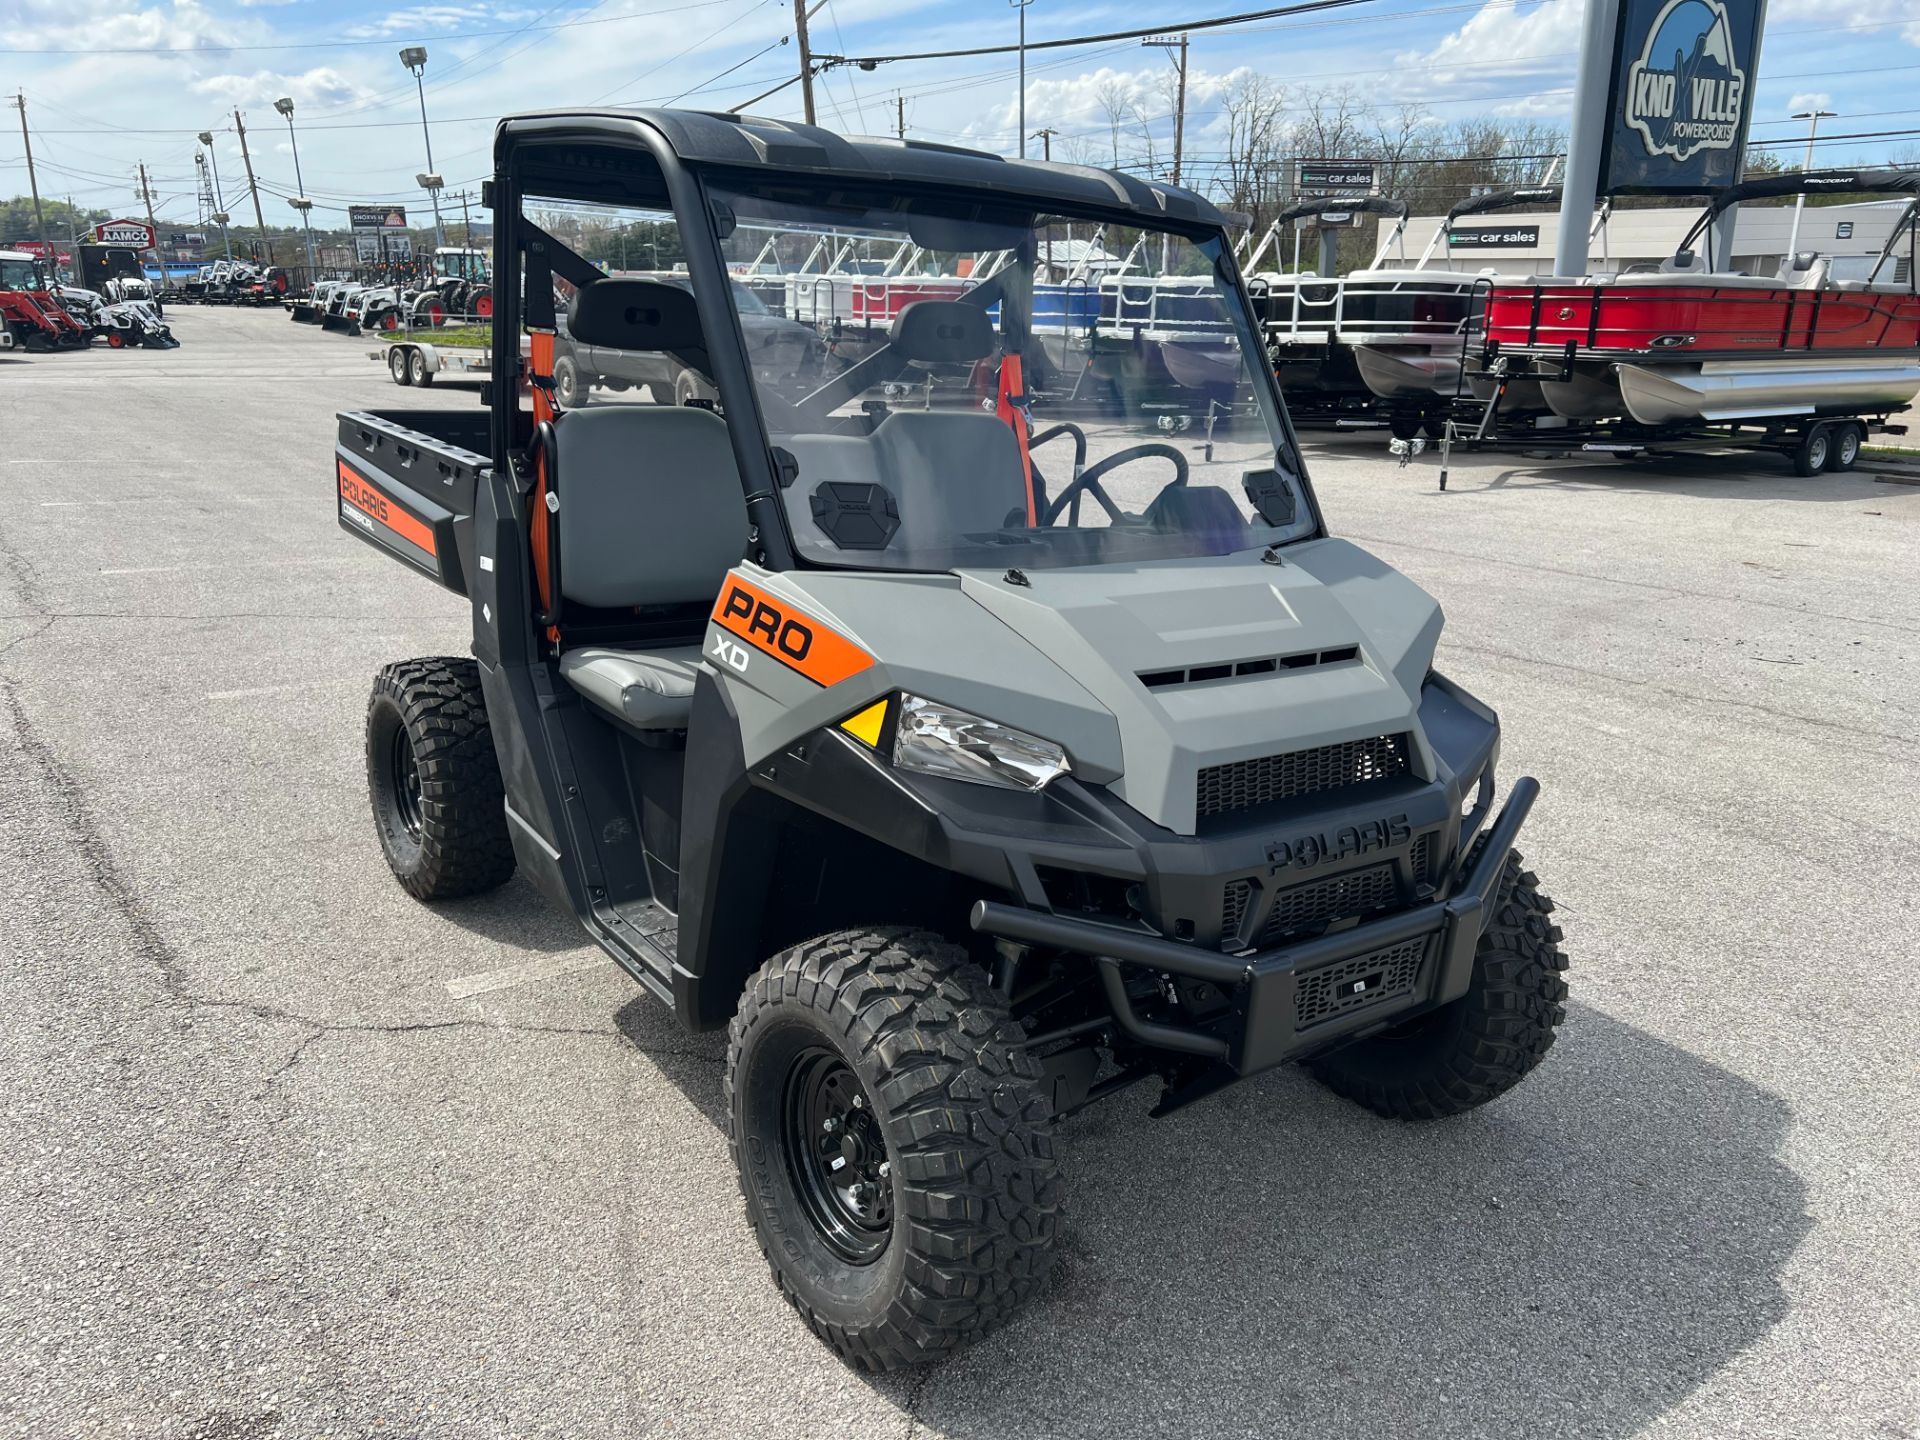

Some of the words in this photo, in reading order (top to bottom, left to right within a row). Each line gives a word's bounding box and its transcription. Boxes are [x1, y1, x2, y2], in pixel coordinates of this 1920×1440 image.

[1634, 72, 1740, 122] KNOXVILLE
[1673, 122, 1733, 140] POWERSPORTS
[1328, 174, 1345, 183] car
[1346, 172, 1372, 183] sales
[103, 231, 150, 241] AAMCO
[1480, 233, 1502, 243] car
[1503, 230, 1536, 243] sales
[342, 475, 389, 522] POLARIS
[722, 586, 813, 662] PRO
[711, 633, 750, 673] XD
[1264, 813, 1412, 877] POLARIS
[747, 1135, 806, 1263] DURO
